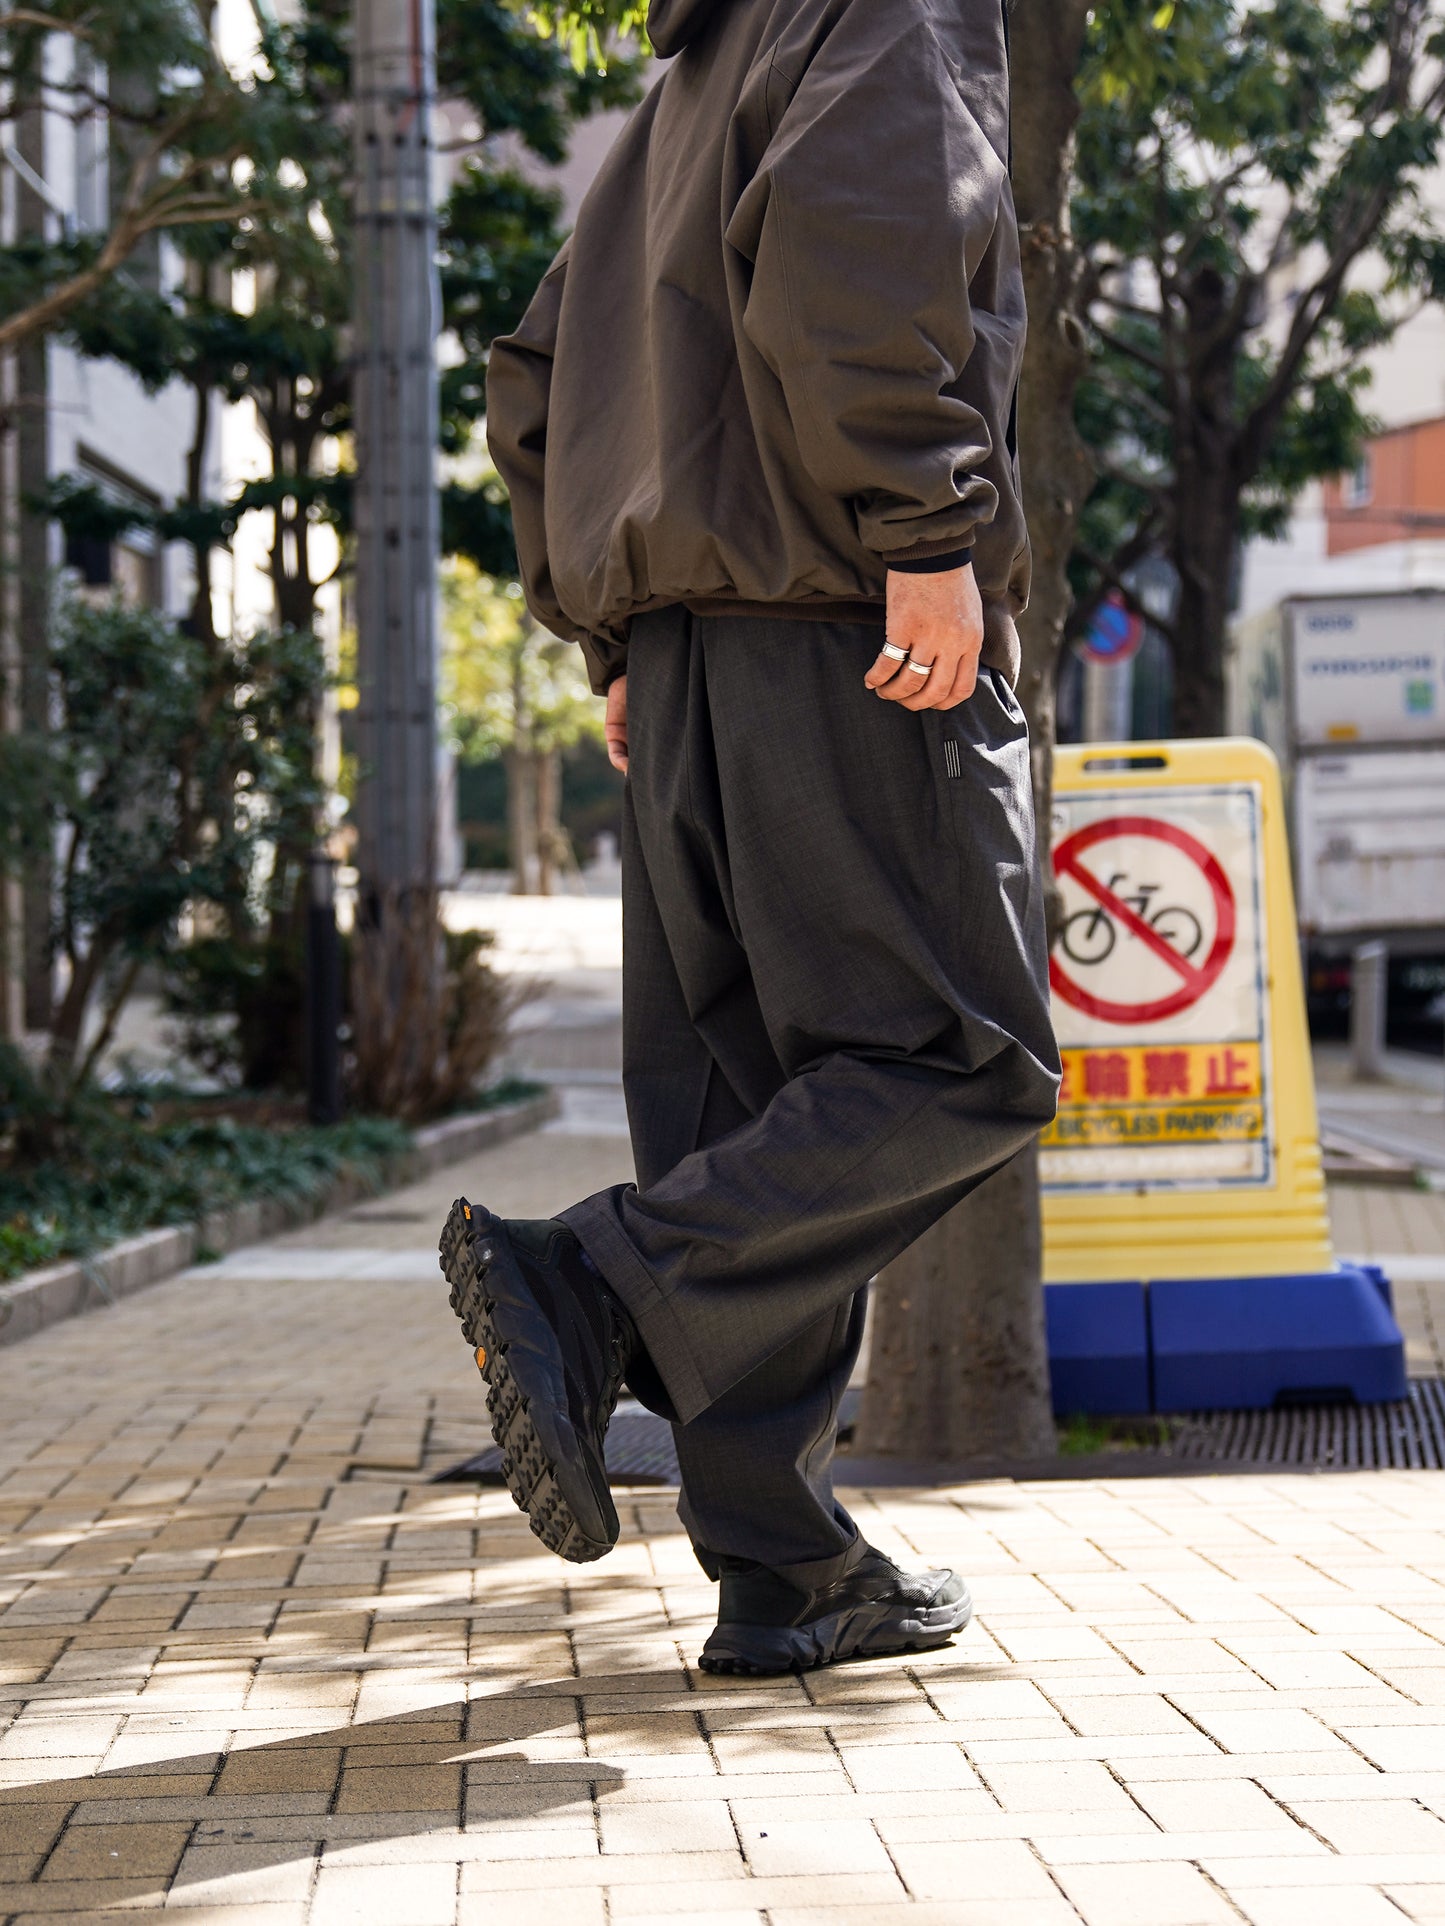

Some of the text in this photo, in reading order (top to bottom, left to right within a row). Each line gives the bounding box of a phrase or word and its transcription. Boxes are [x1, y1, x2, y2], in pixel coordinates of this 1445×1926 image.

[1059, 1049, 1251, 1099] 輪禁止
[1058, 1115, 1159, 1138] BICYCLES
[1166, 1111, 1258, 1132] PARKING
